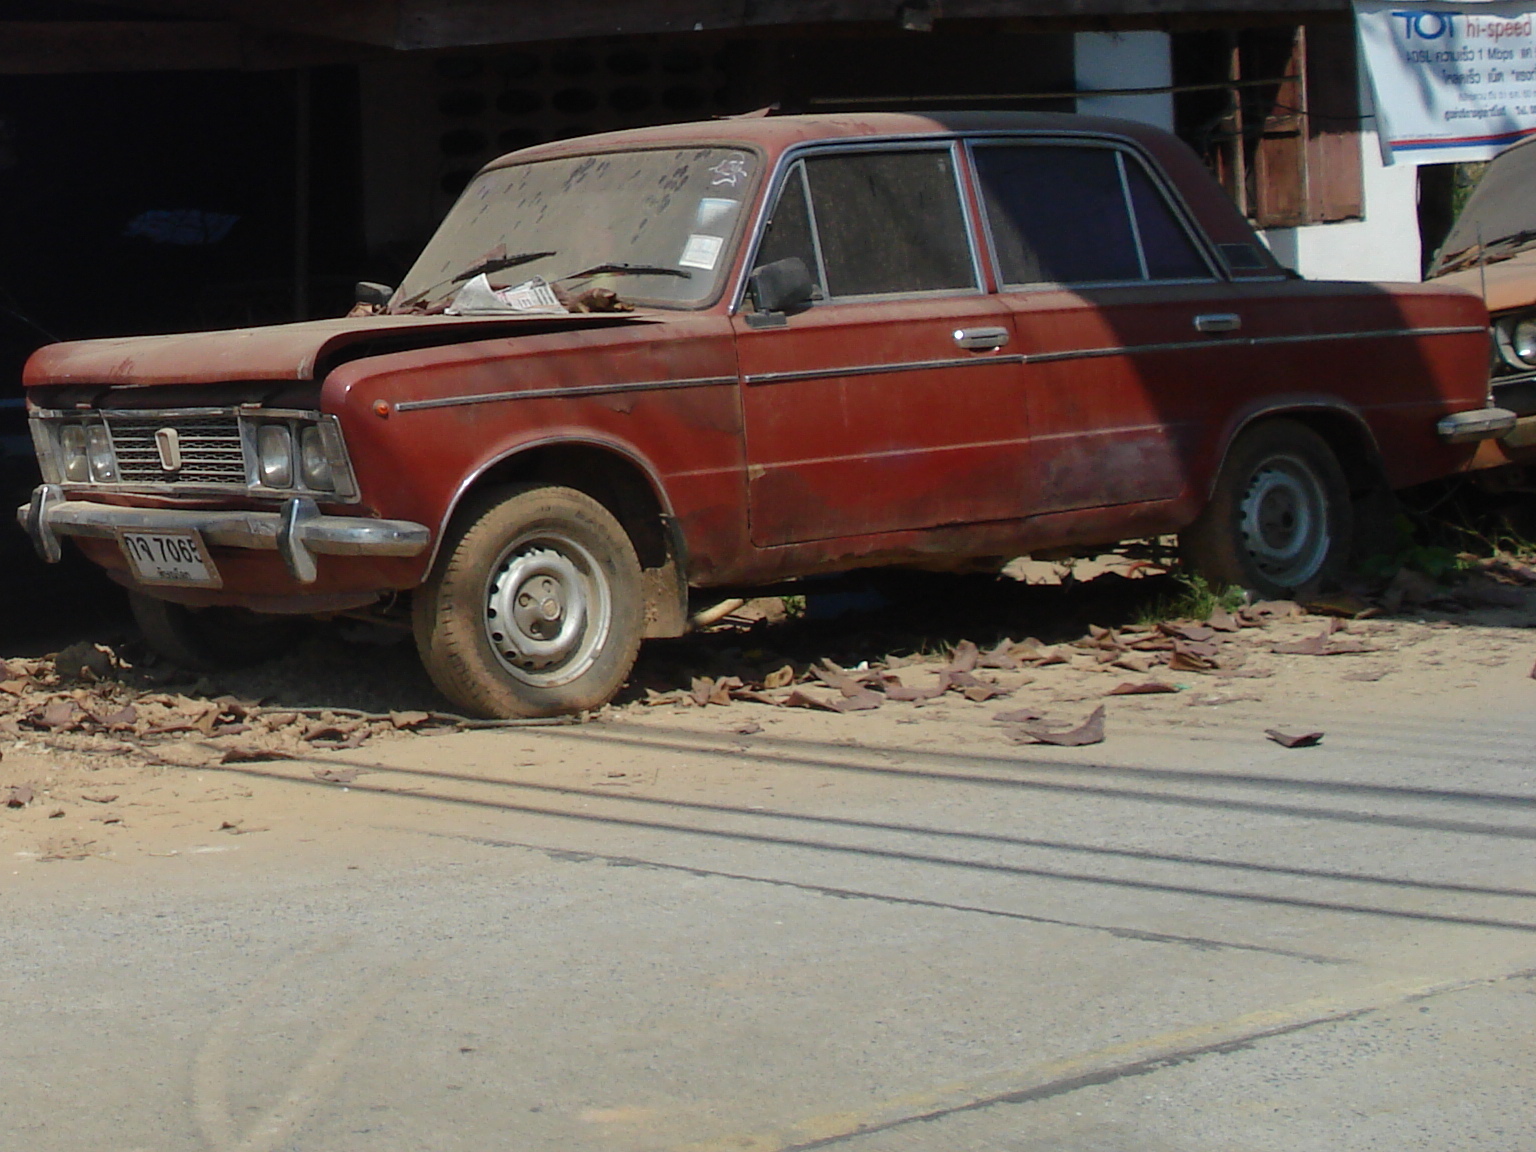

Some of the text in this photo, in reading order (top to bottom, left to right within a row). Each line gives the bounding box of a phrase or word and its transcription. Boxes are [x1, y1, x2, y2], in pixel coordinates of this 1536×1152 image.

[1392, 11, 1532, 43] TOT hi-speed
[153, 538, 203, 563] 7065
